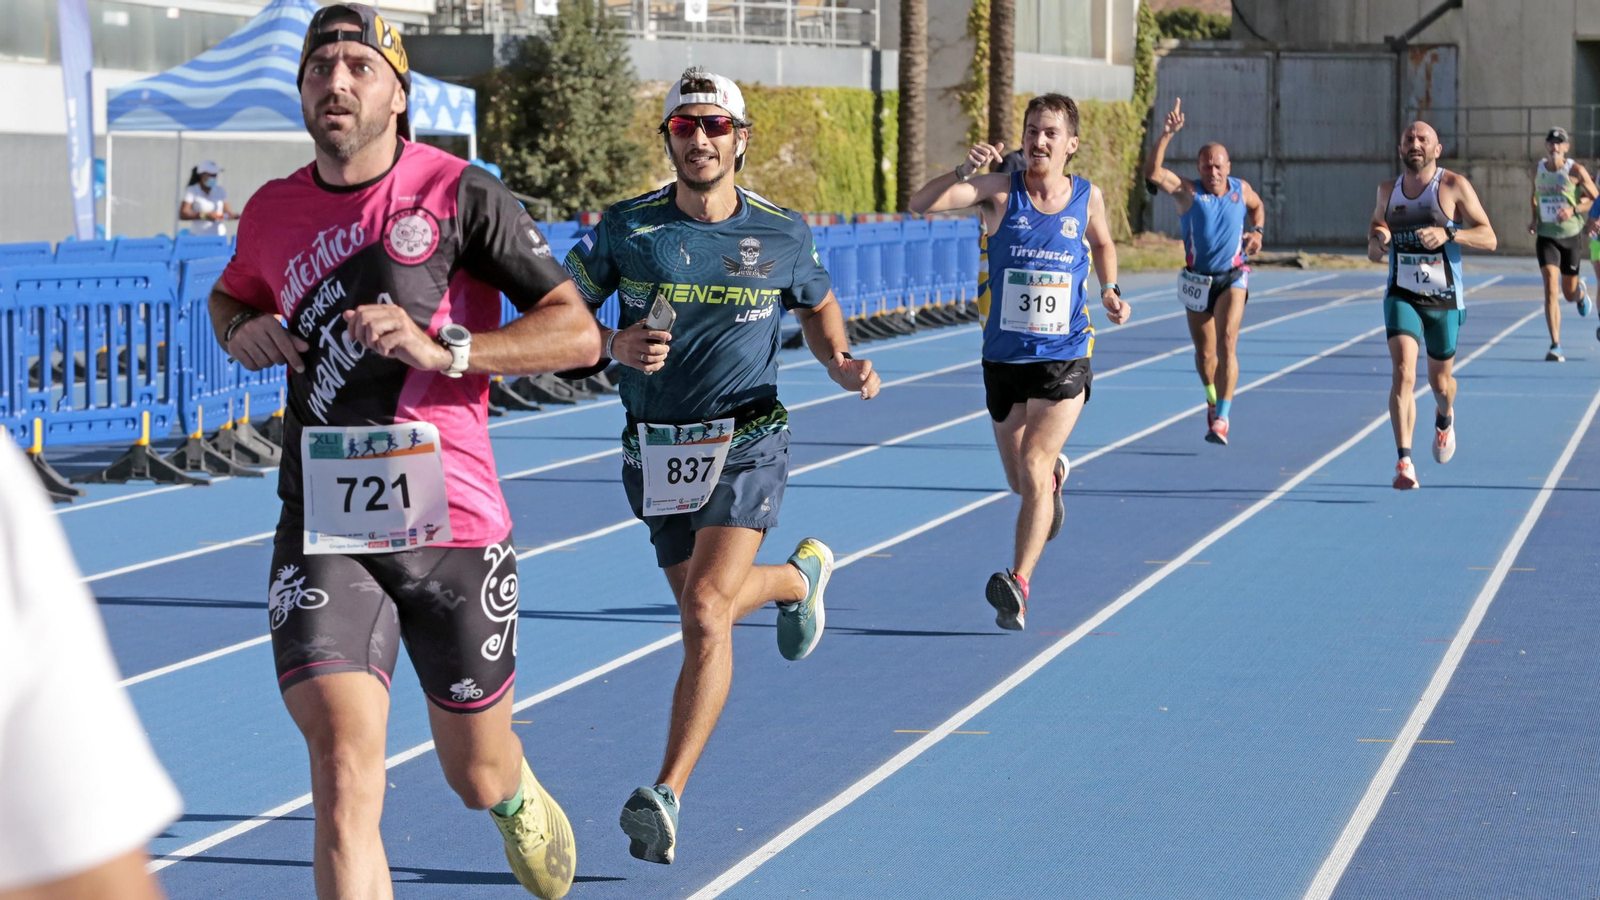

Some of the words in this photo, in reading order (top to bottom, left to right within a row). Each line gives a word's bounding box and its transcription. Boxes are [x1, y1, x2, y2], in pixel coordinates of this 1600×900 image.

[1009, 245, 1074, 264] Tirabuzón
[1413, 270, 1430, 284] 12
[1182, 284, 1202, 299] 660
[1019, 293, 1056, 314] 319
[314, 433, 339, 445] XLI
[667, 456, 716, 484] 837
[336, 473, 411, 513] 721
